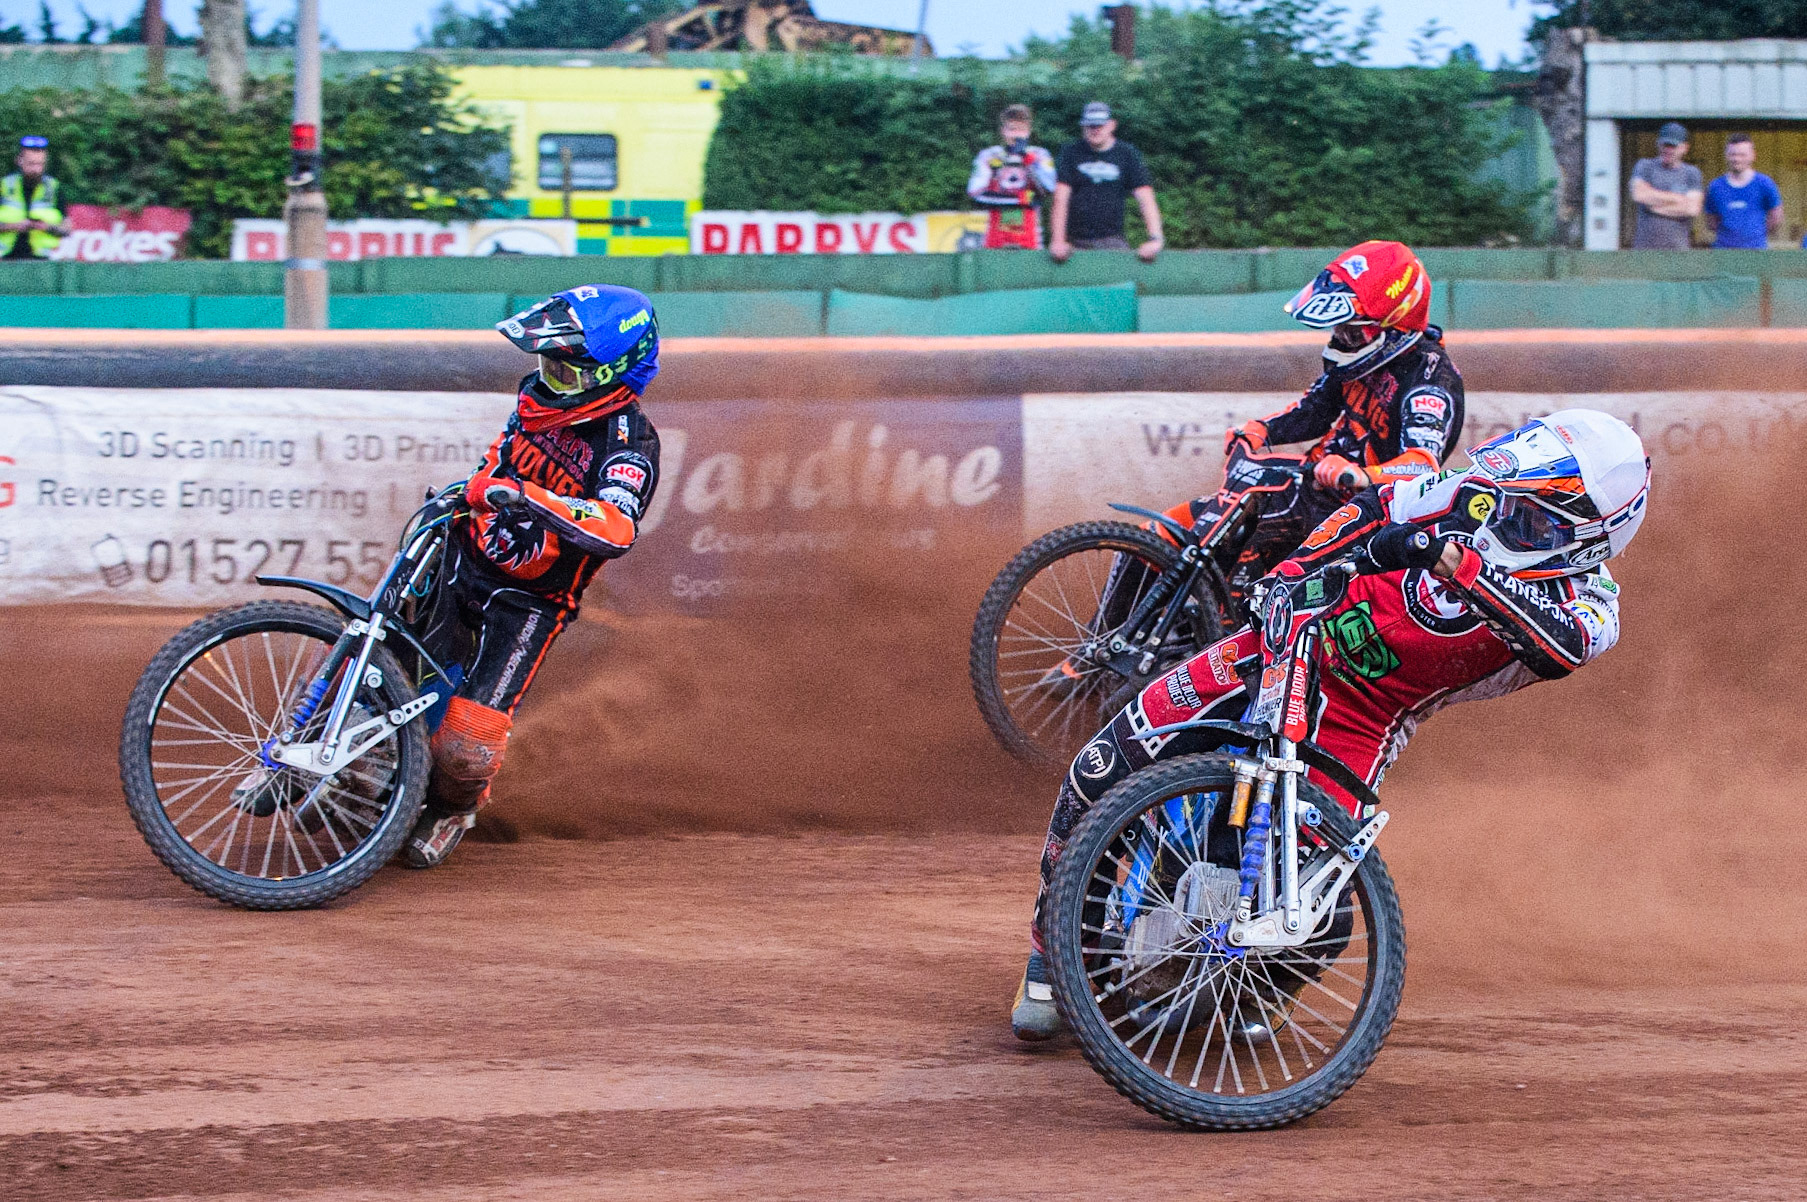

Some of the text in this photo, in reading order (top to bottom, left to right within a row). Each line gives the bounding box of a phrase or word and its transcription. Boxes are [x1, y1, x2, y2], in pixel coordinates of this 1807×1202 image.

[56, 221, 180, 261] rokes
[1414, 395, 1447, 412] NGK
[100, 431, 296, 467] 3D Scanning
[344, 434, 383, 461] 3D
[545, 427, 595, 473] ARRYS
[610, 467, 645, 482] NGK
[38, 479, 166, 508] Reverse
[179, 481, 368, 518] Engineering
[146, 538, 305, 584] 01527
[1166, 673, 1189, 707] PROJECT
[1291, 665, 1305, 695] DOOR
[1181, 685, 1203, 709] DOOR
[1286, 697, 1301, 726] BLUE
[1087, 747, 1107, 773] ATPI
